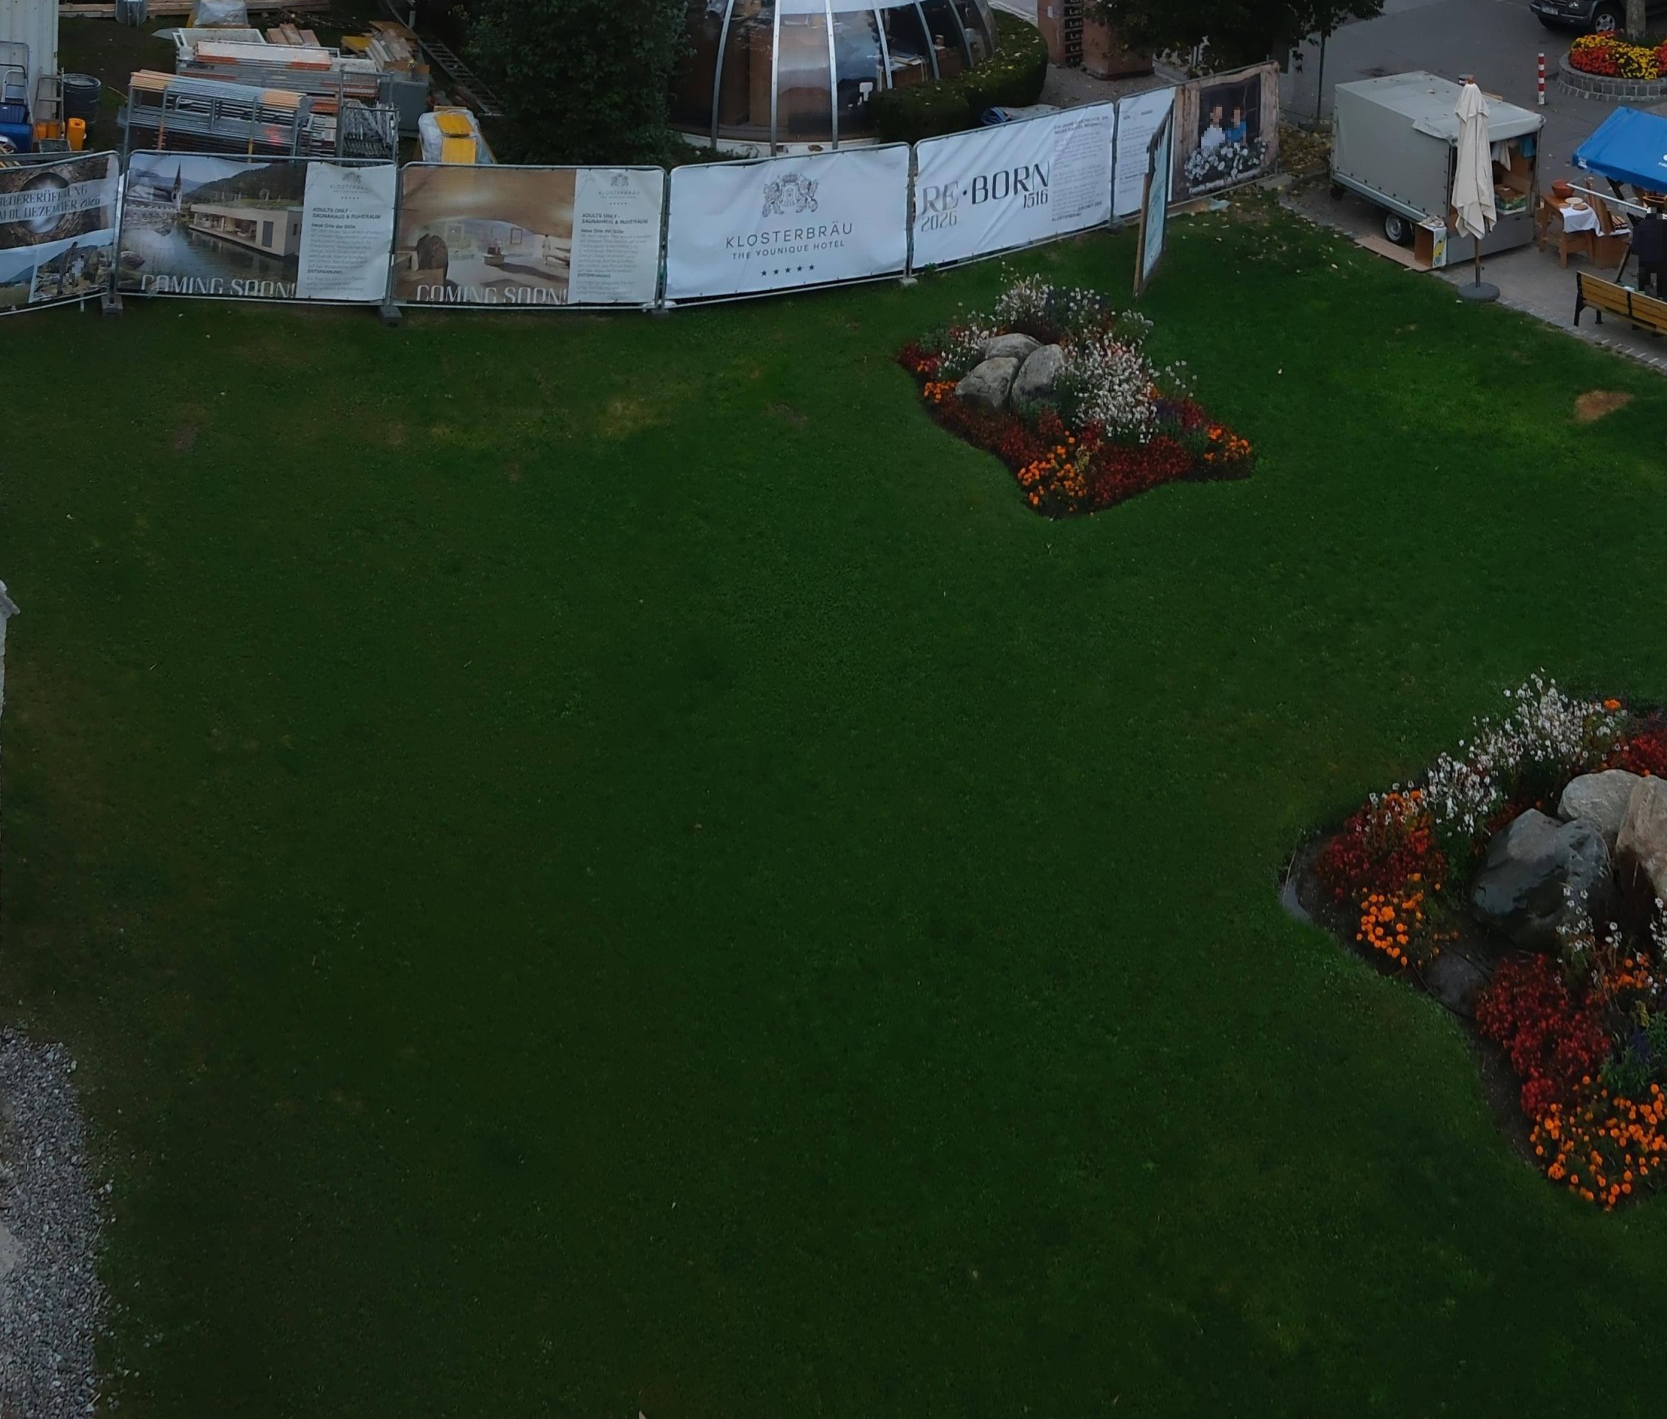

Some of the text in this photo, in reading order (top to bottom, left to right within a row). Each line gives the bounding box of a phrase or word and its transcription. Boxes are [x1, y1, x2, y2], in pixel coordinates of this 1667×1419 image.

[1022, 188, 1049, 210] 1516
[921, 210, 958, 232] 2026
[725, 221, 853, 249] KLOSTERBRÄU
[732, 239, 845, 260] THE YOUNIQUE HOTEL
[140, 273, 223, 295] COMING
[416, 284, 497, 303] COMING
